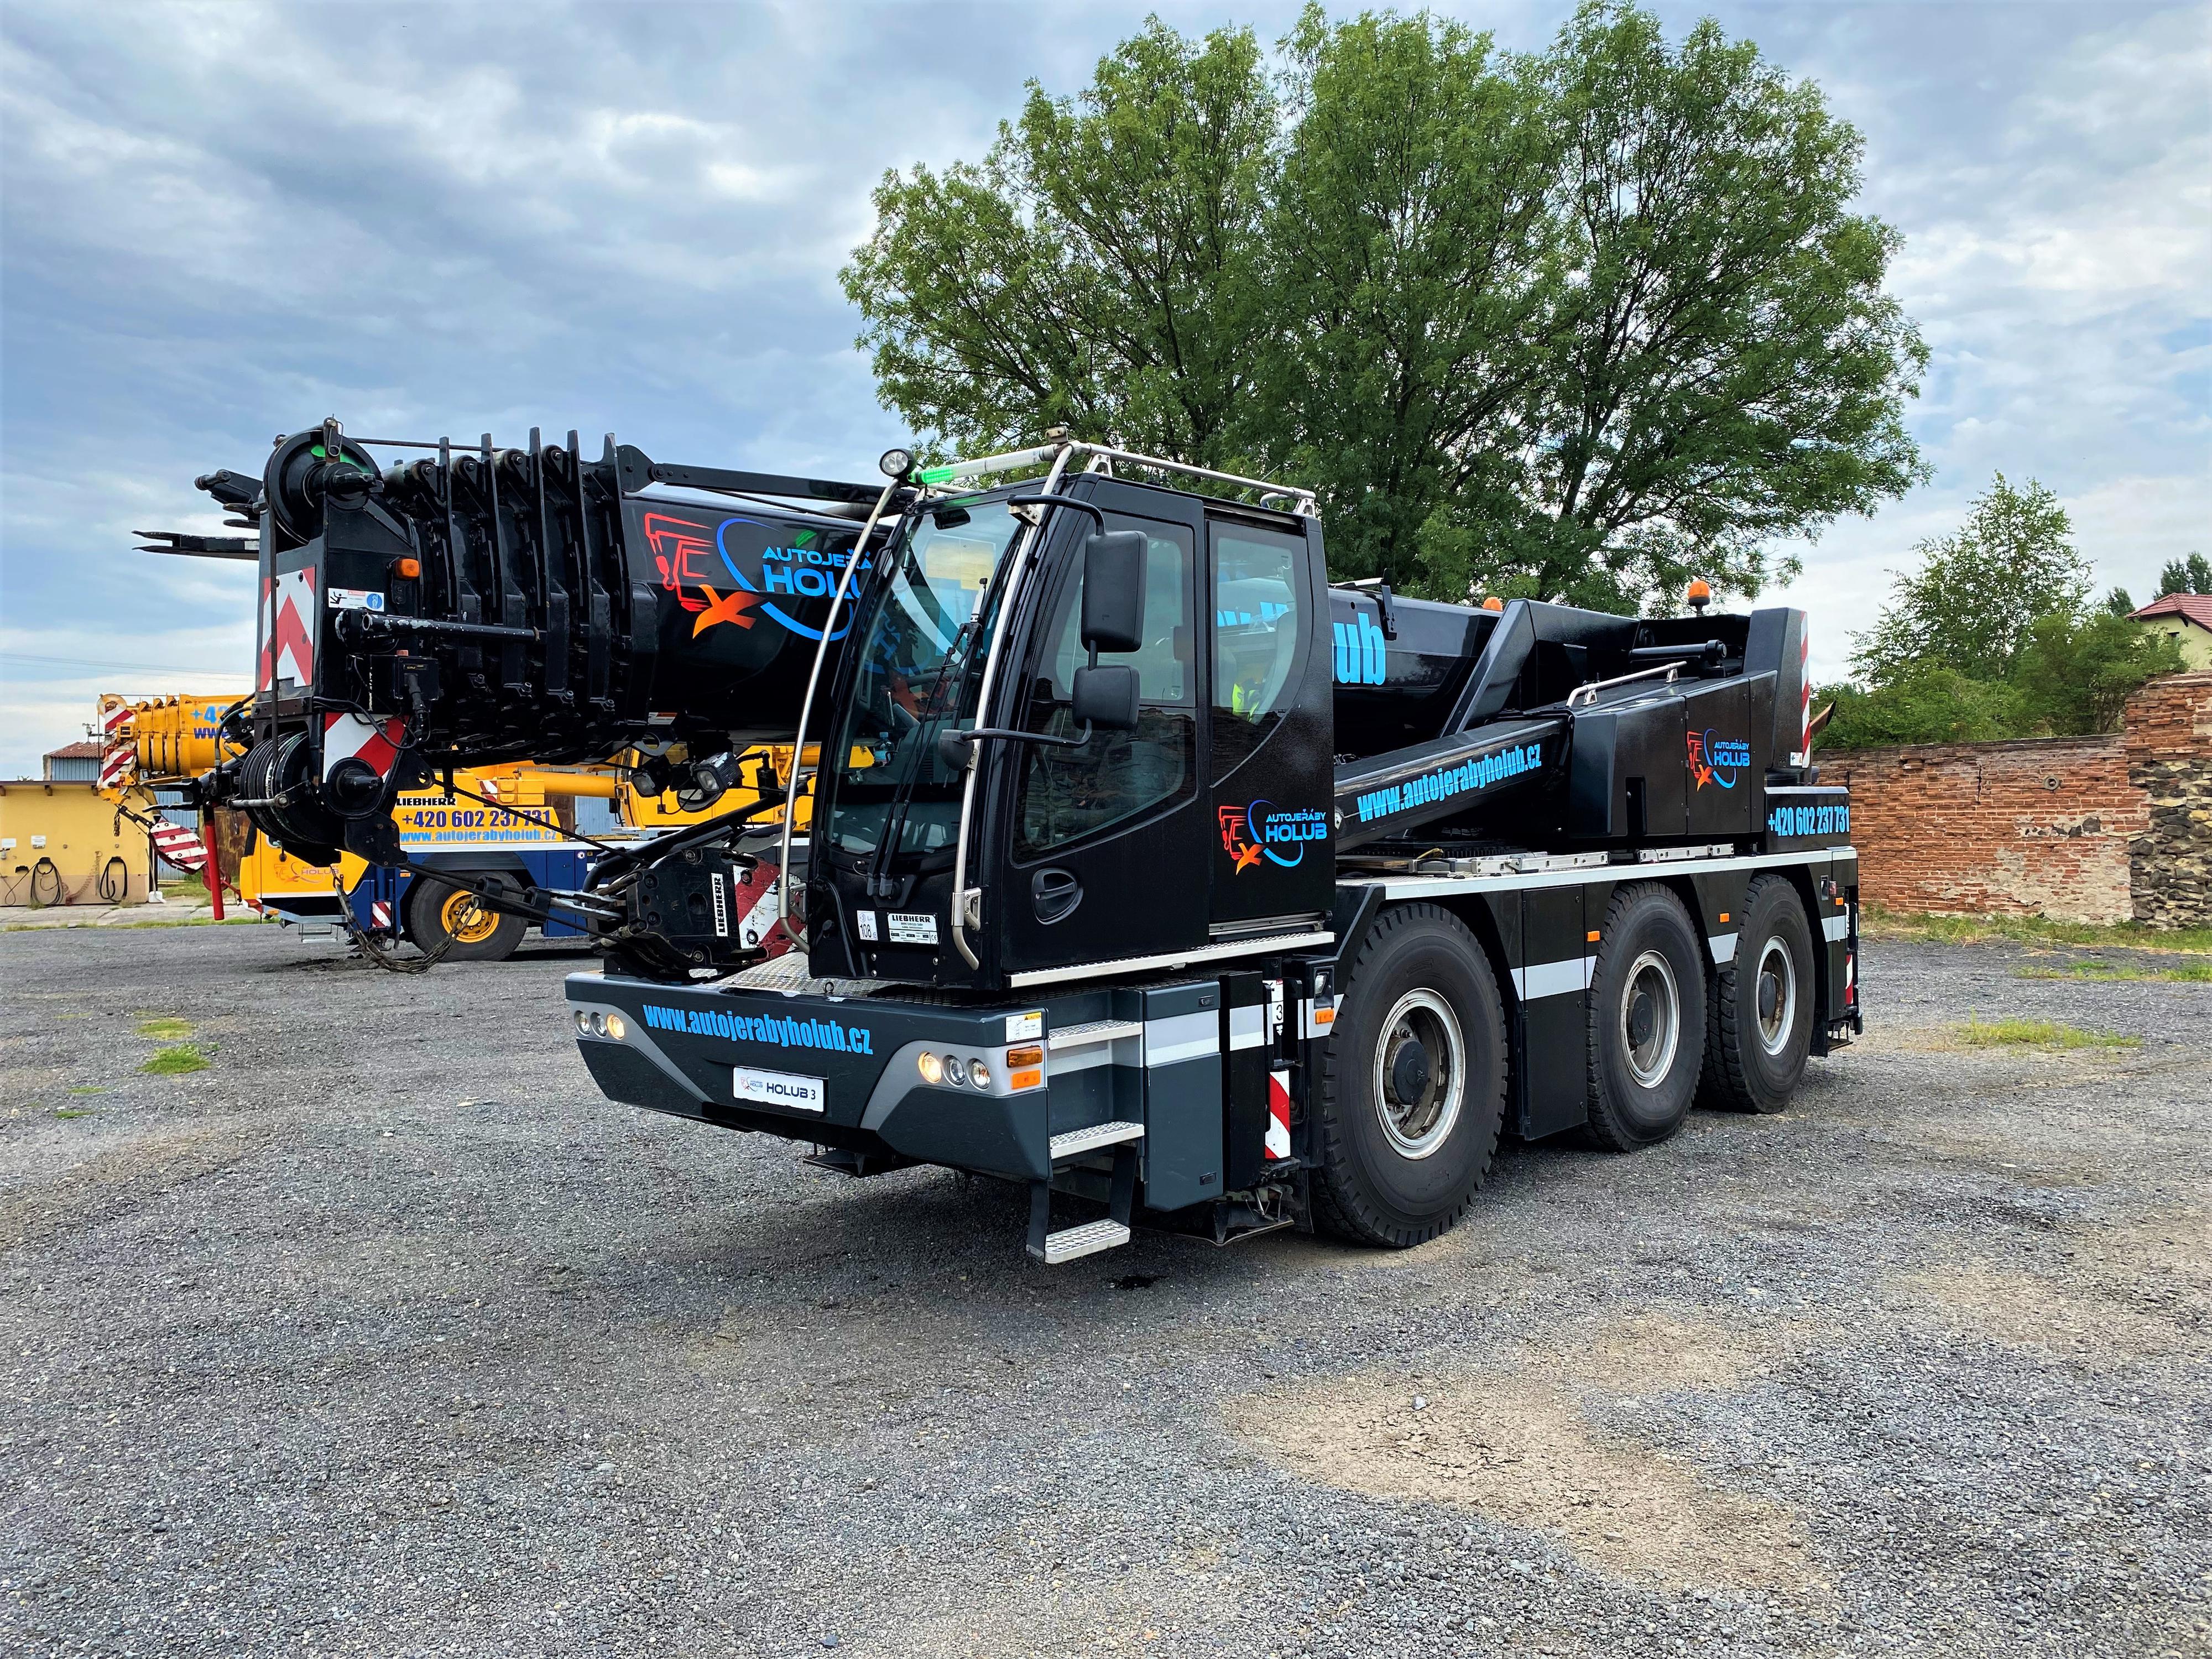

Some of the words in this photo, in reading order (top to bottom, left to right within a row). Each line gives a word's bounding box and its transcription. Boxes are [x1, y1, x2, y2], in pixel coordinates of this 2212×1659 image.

[1332, 612, 1386, 686] ub
[1714, 739, 1749, 750] AUTOJEŘÁBY
[1714, 751, 1750, 766] HOLUB
[1357, 744, 1542, 822] www.autojerabyholub.cz
[396, 797, 456, 806] LIEBHERR
[402, 810, 446, 827] +420
[451, 810, 485, 827] 602
[523, 809, 550, 826] 731
[1266, 808, 1326, 823] AUTOJEŘÁBY
[1768, 807, 1794, 836] +420
[1796, 806, 1815, 836] 602
[1817, 806, 1833, 834] 237
[1834, 805, 1850, 833] 731
[399, 829, 556, 842] www.autojerabyholub.cz
[1265, 822, 1327, 842] HOLUB
[714, 877, 726, 933] LIEBHERR
[891, 915, 931, 923] LIEBHERR
[859, 924, 872, 938] 108
[642, 1004, 873, 1055] www.autojerabyholub.cz
[766, 1082, 808, 1099] HOLUB
[811, 1089, 816, 1100] 3
